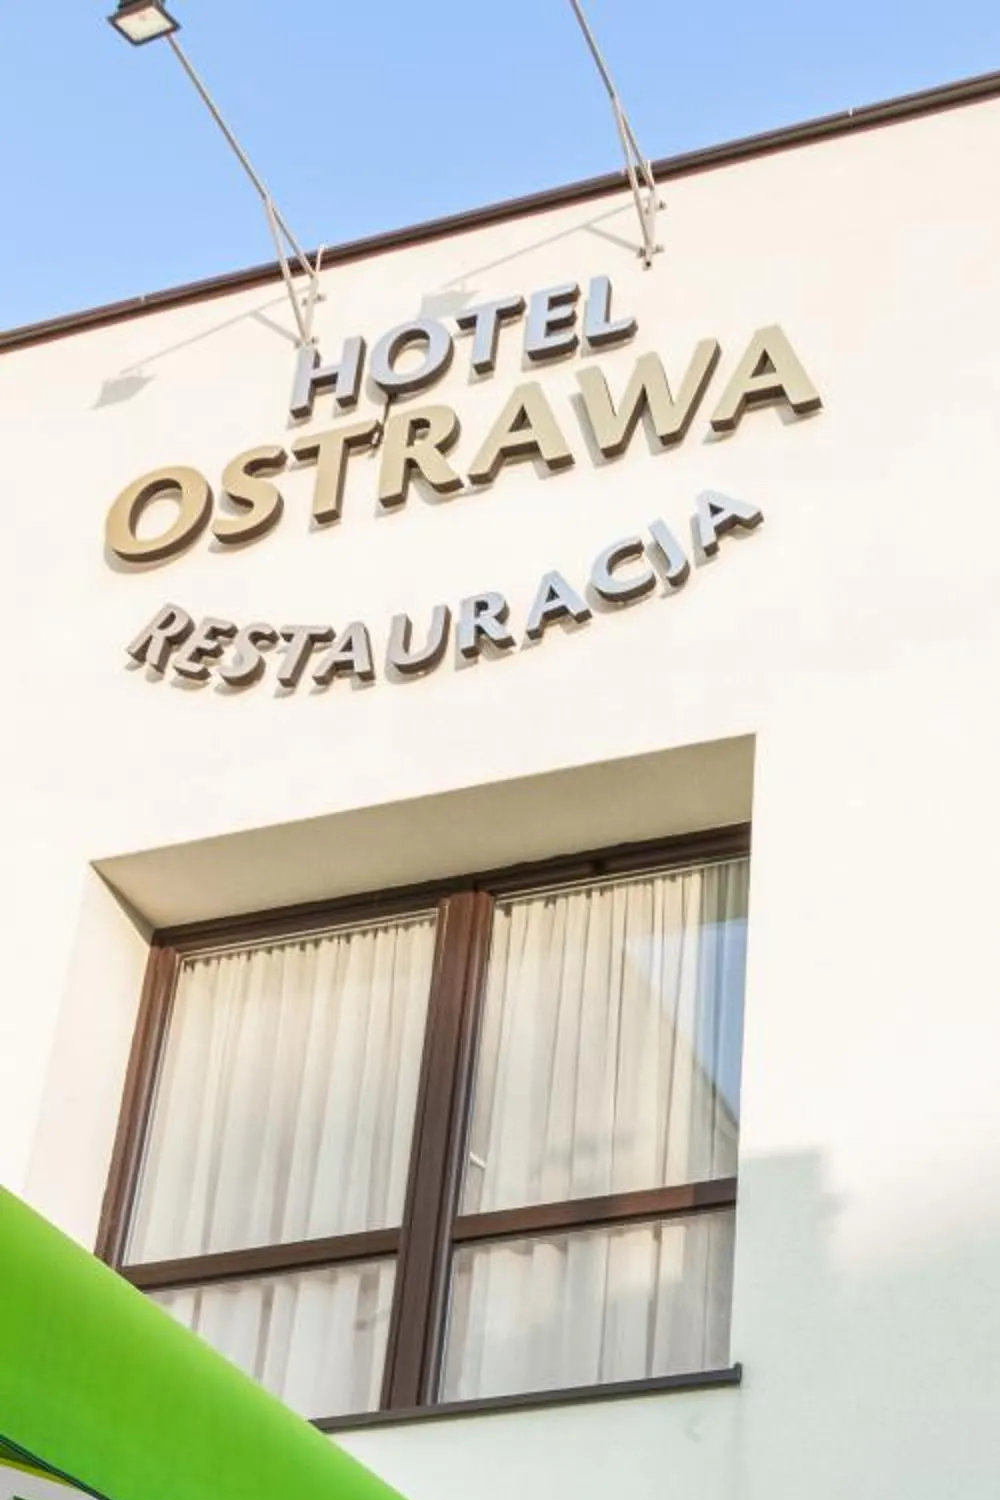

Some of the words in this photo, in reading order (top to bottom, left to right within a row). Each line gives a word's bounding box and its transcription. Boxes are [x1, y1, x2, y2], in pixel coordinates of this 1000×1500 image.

[105, 323, 826, 563] OSTRAWA
[288, 275, 640, 420] HOTEL
[126, 487, 764, 689] RESTAURACJA
